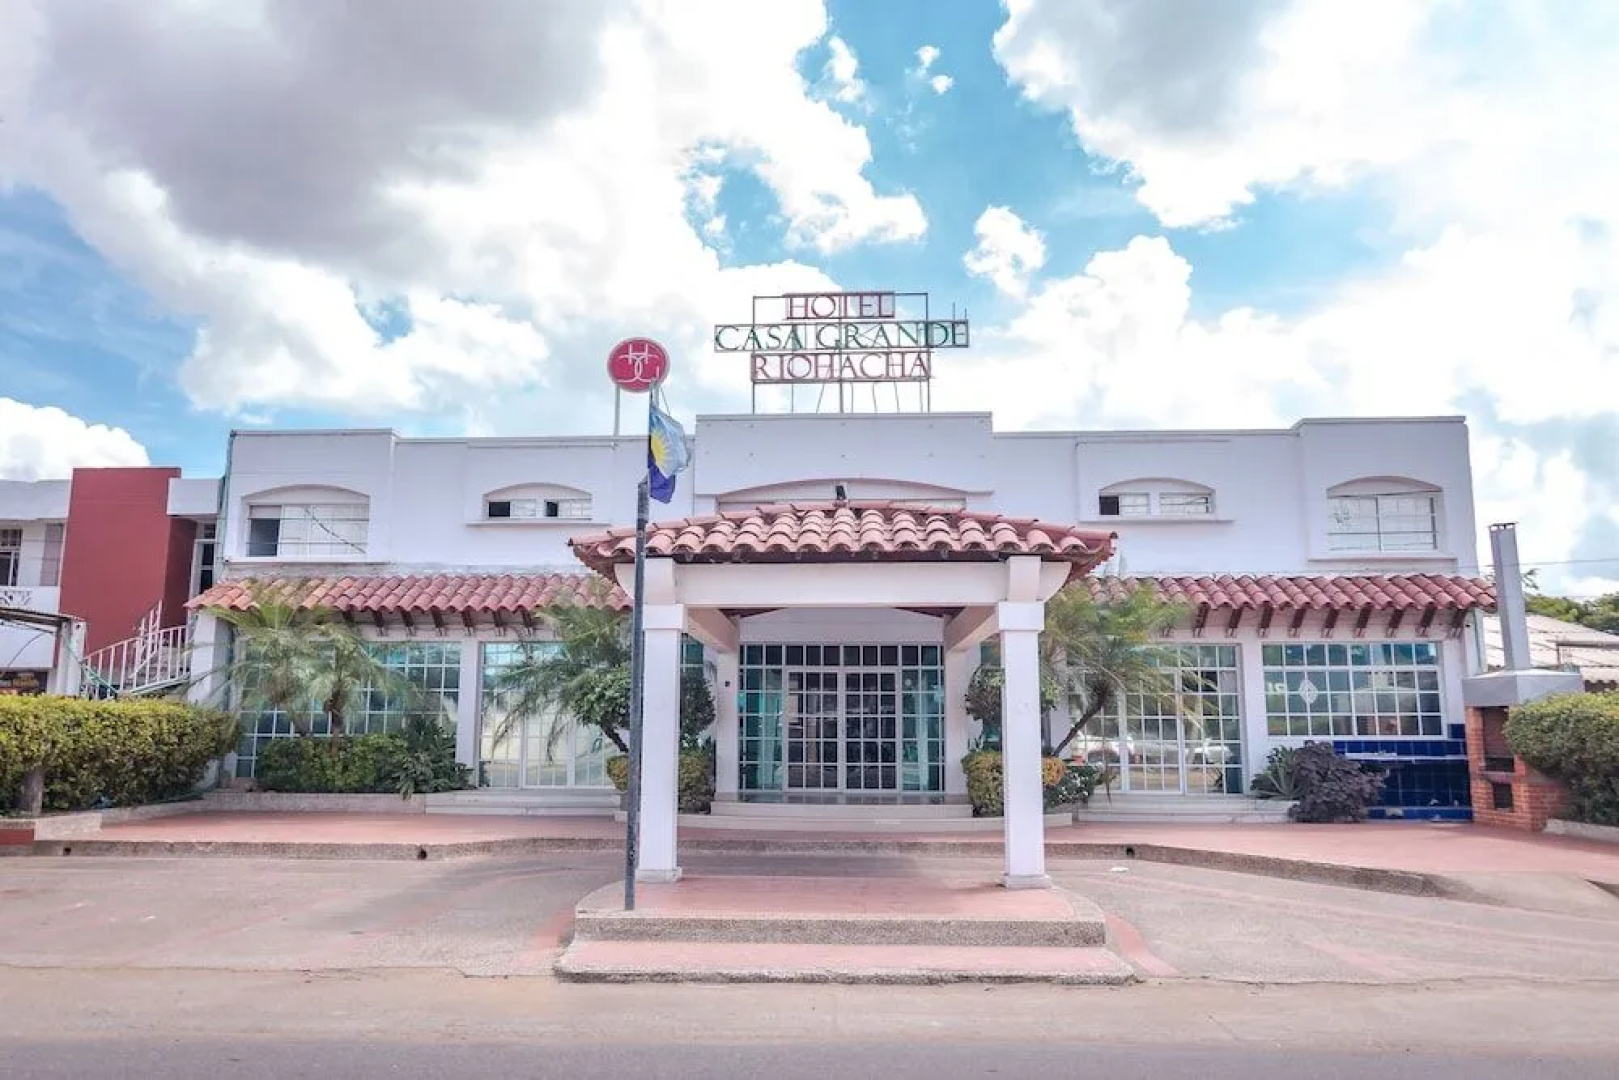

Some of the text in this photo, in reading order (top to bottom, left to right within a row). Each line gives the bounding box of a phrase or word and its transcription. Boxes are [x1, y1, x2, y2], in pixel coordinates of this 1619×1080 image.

[787, 293, 894, 319] HOTEL
[715, 321, 968, 350] CASA GRANDE
[751, 353, 929, 380] RIOHACHA
